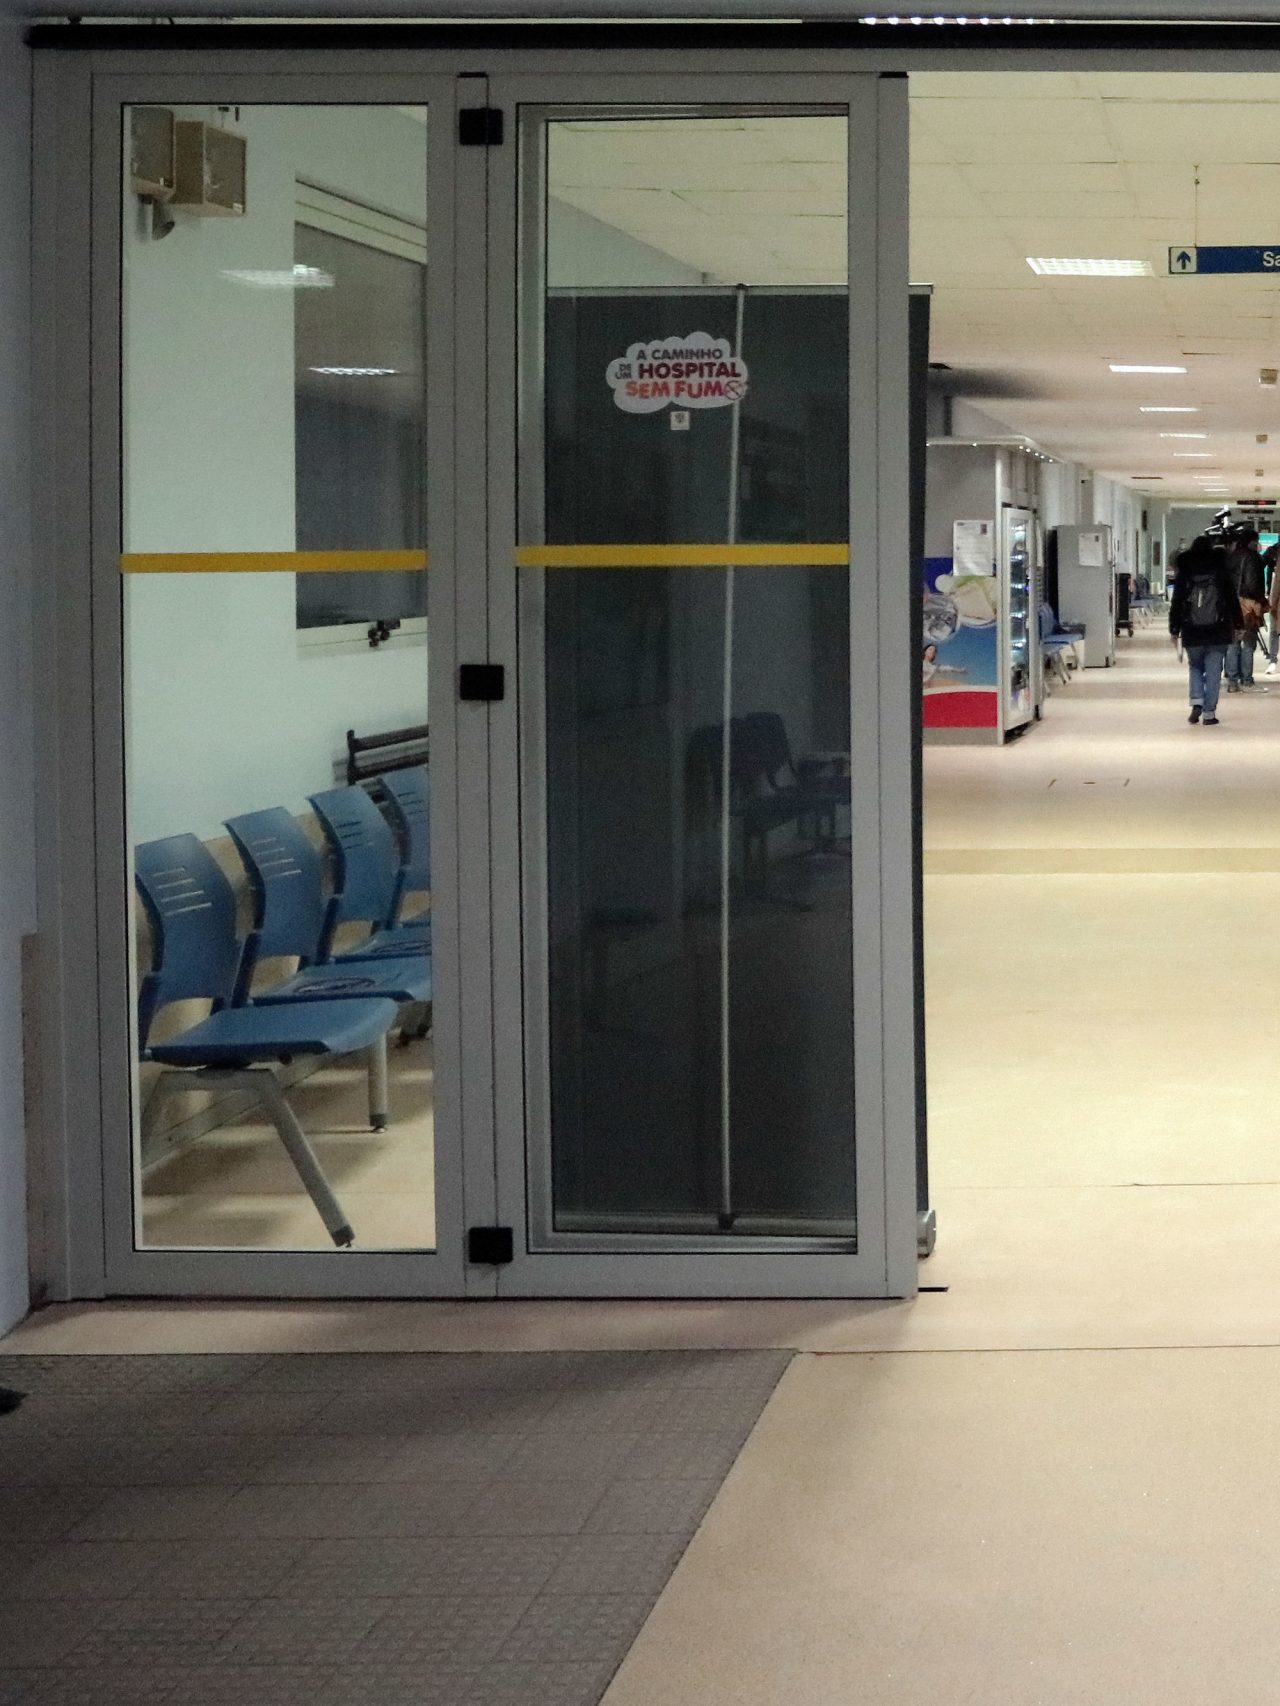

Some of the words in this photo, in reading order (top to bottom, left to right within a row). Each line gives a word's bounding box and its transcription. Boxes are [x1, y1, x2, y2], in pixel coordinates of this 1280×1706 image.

[636, 350, 647, 360] A
[651, 349, 723, 360] CAMINHO
[638, 362, 741, 379] HOSPITAL
[625, 380, 670, 399] SEM
